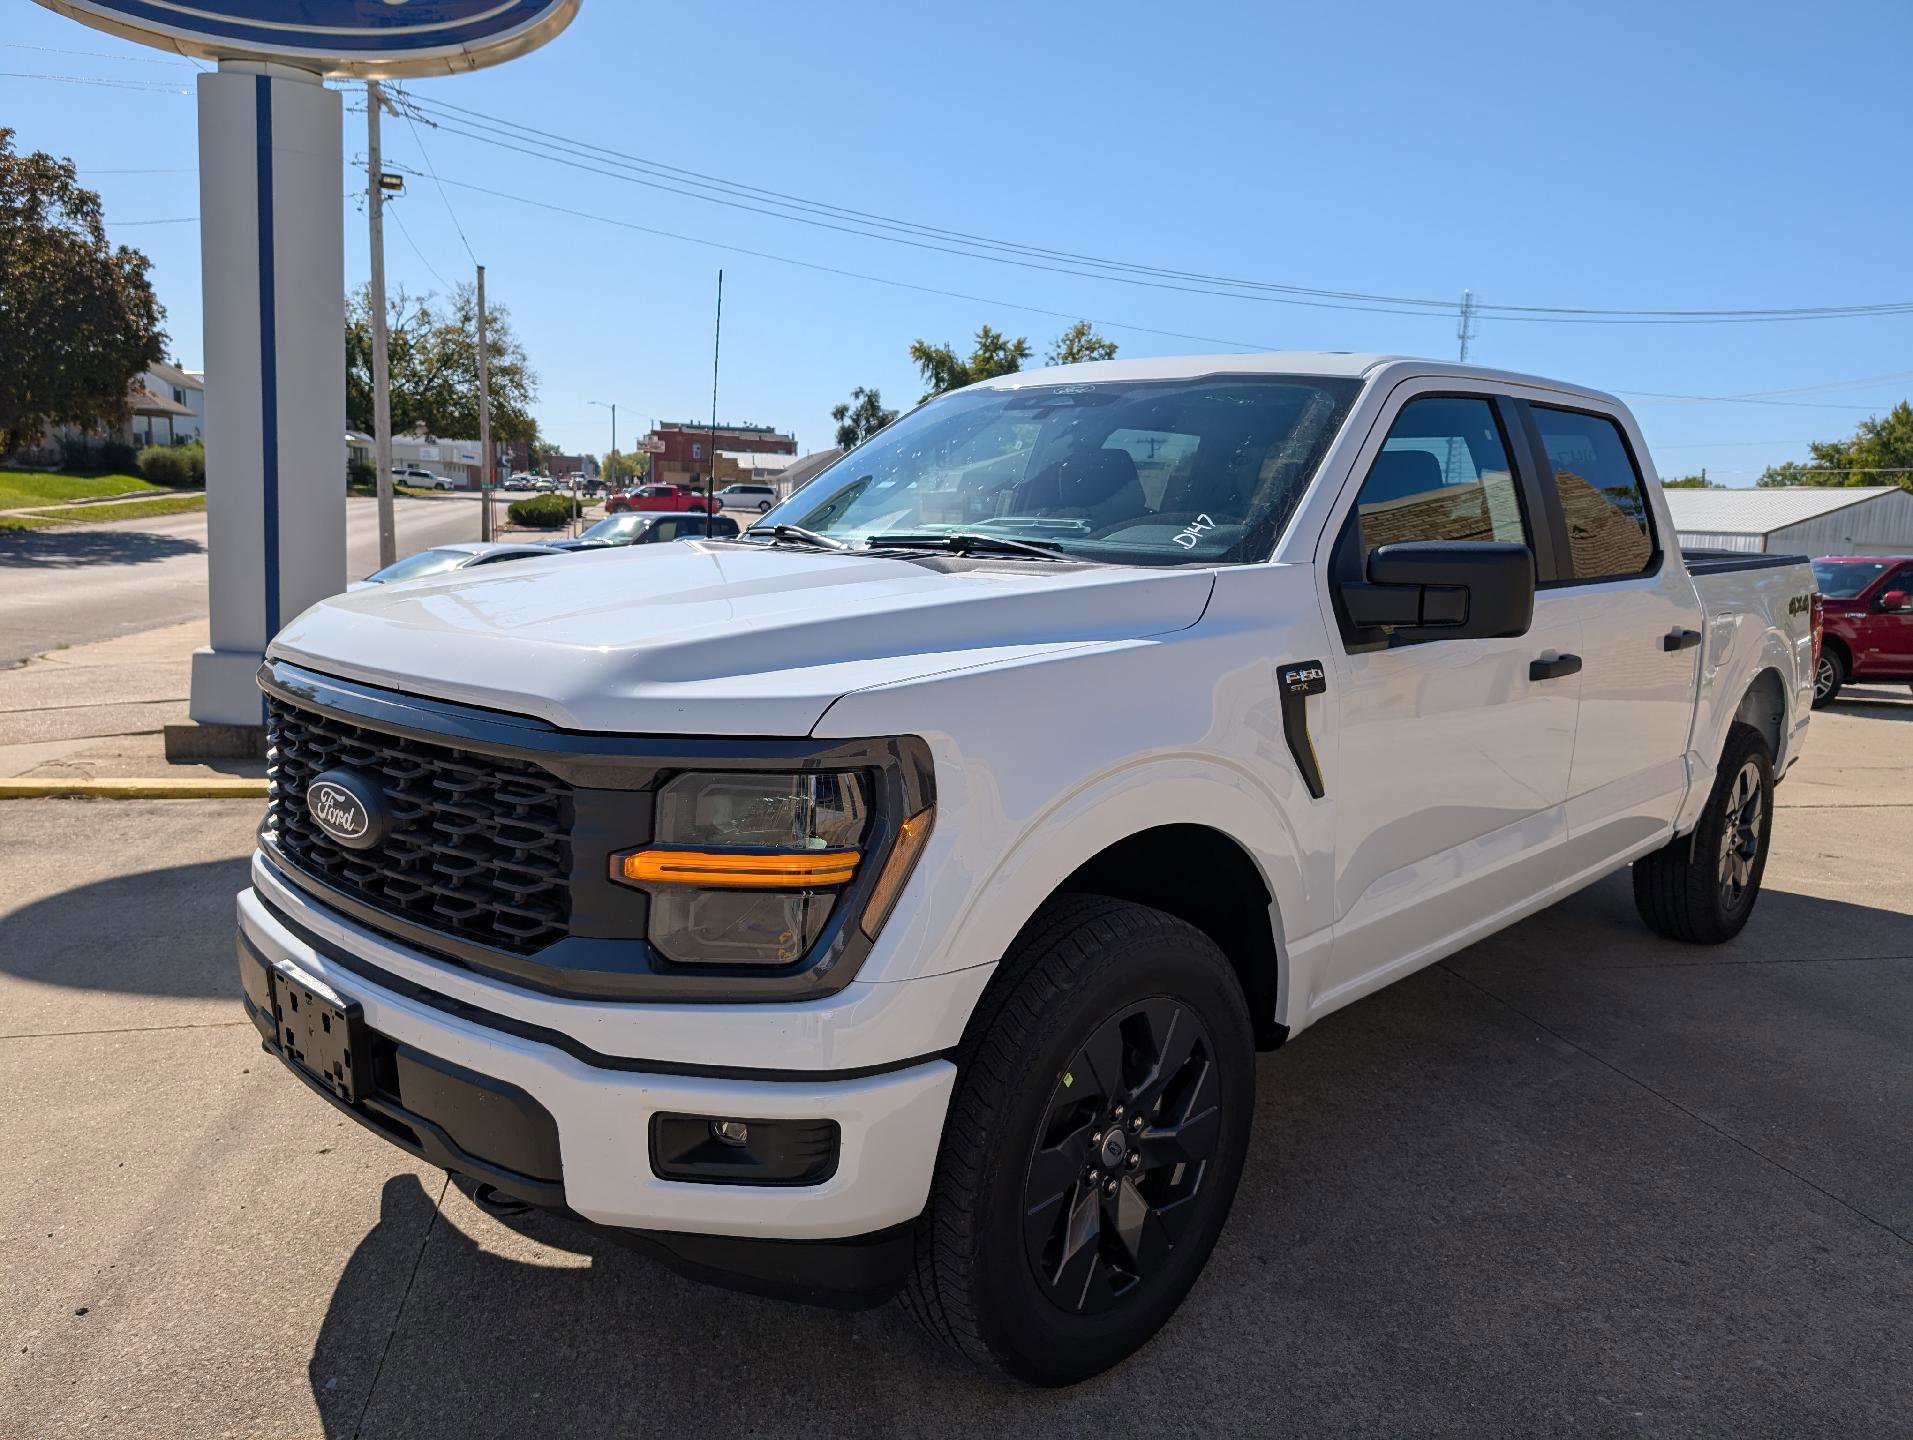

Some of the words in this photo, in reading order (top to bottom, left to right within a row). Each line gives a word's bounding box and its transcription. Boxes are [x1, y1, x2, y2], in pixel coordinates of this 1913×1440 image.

[1173, 514, 1216, 549] D147
[1286, 668, 1323, 684] F-150
[1291, 683, 1309, 692] STX
[318, 787, 355, 831] Ford
